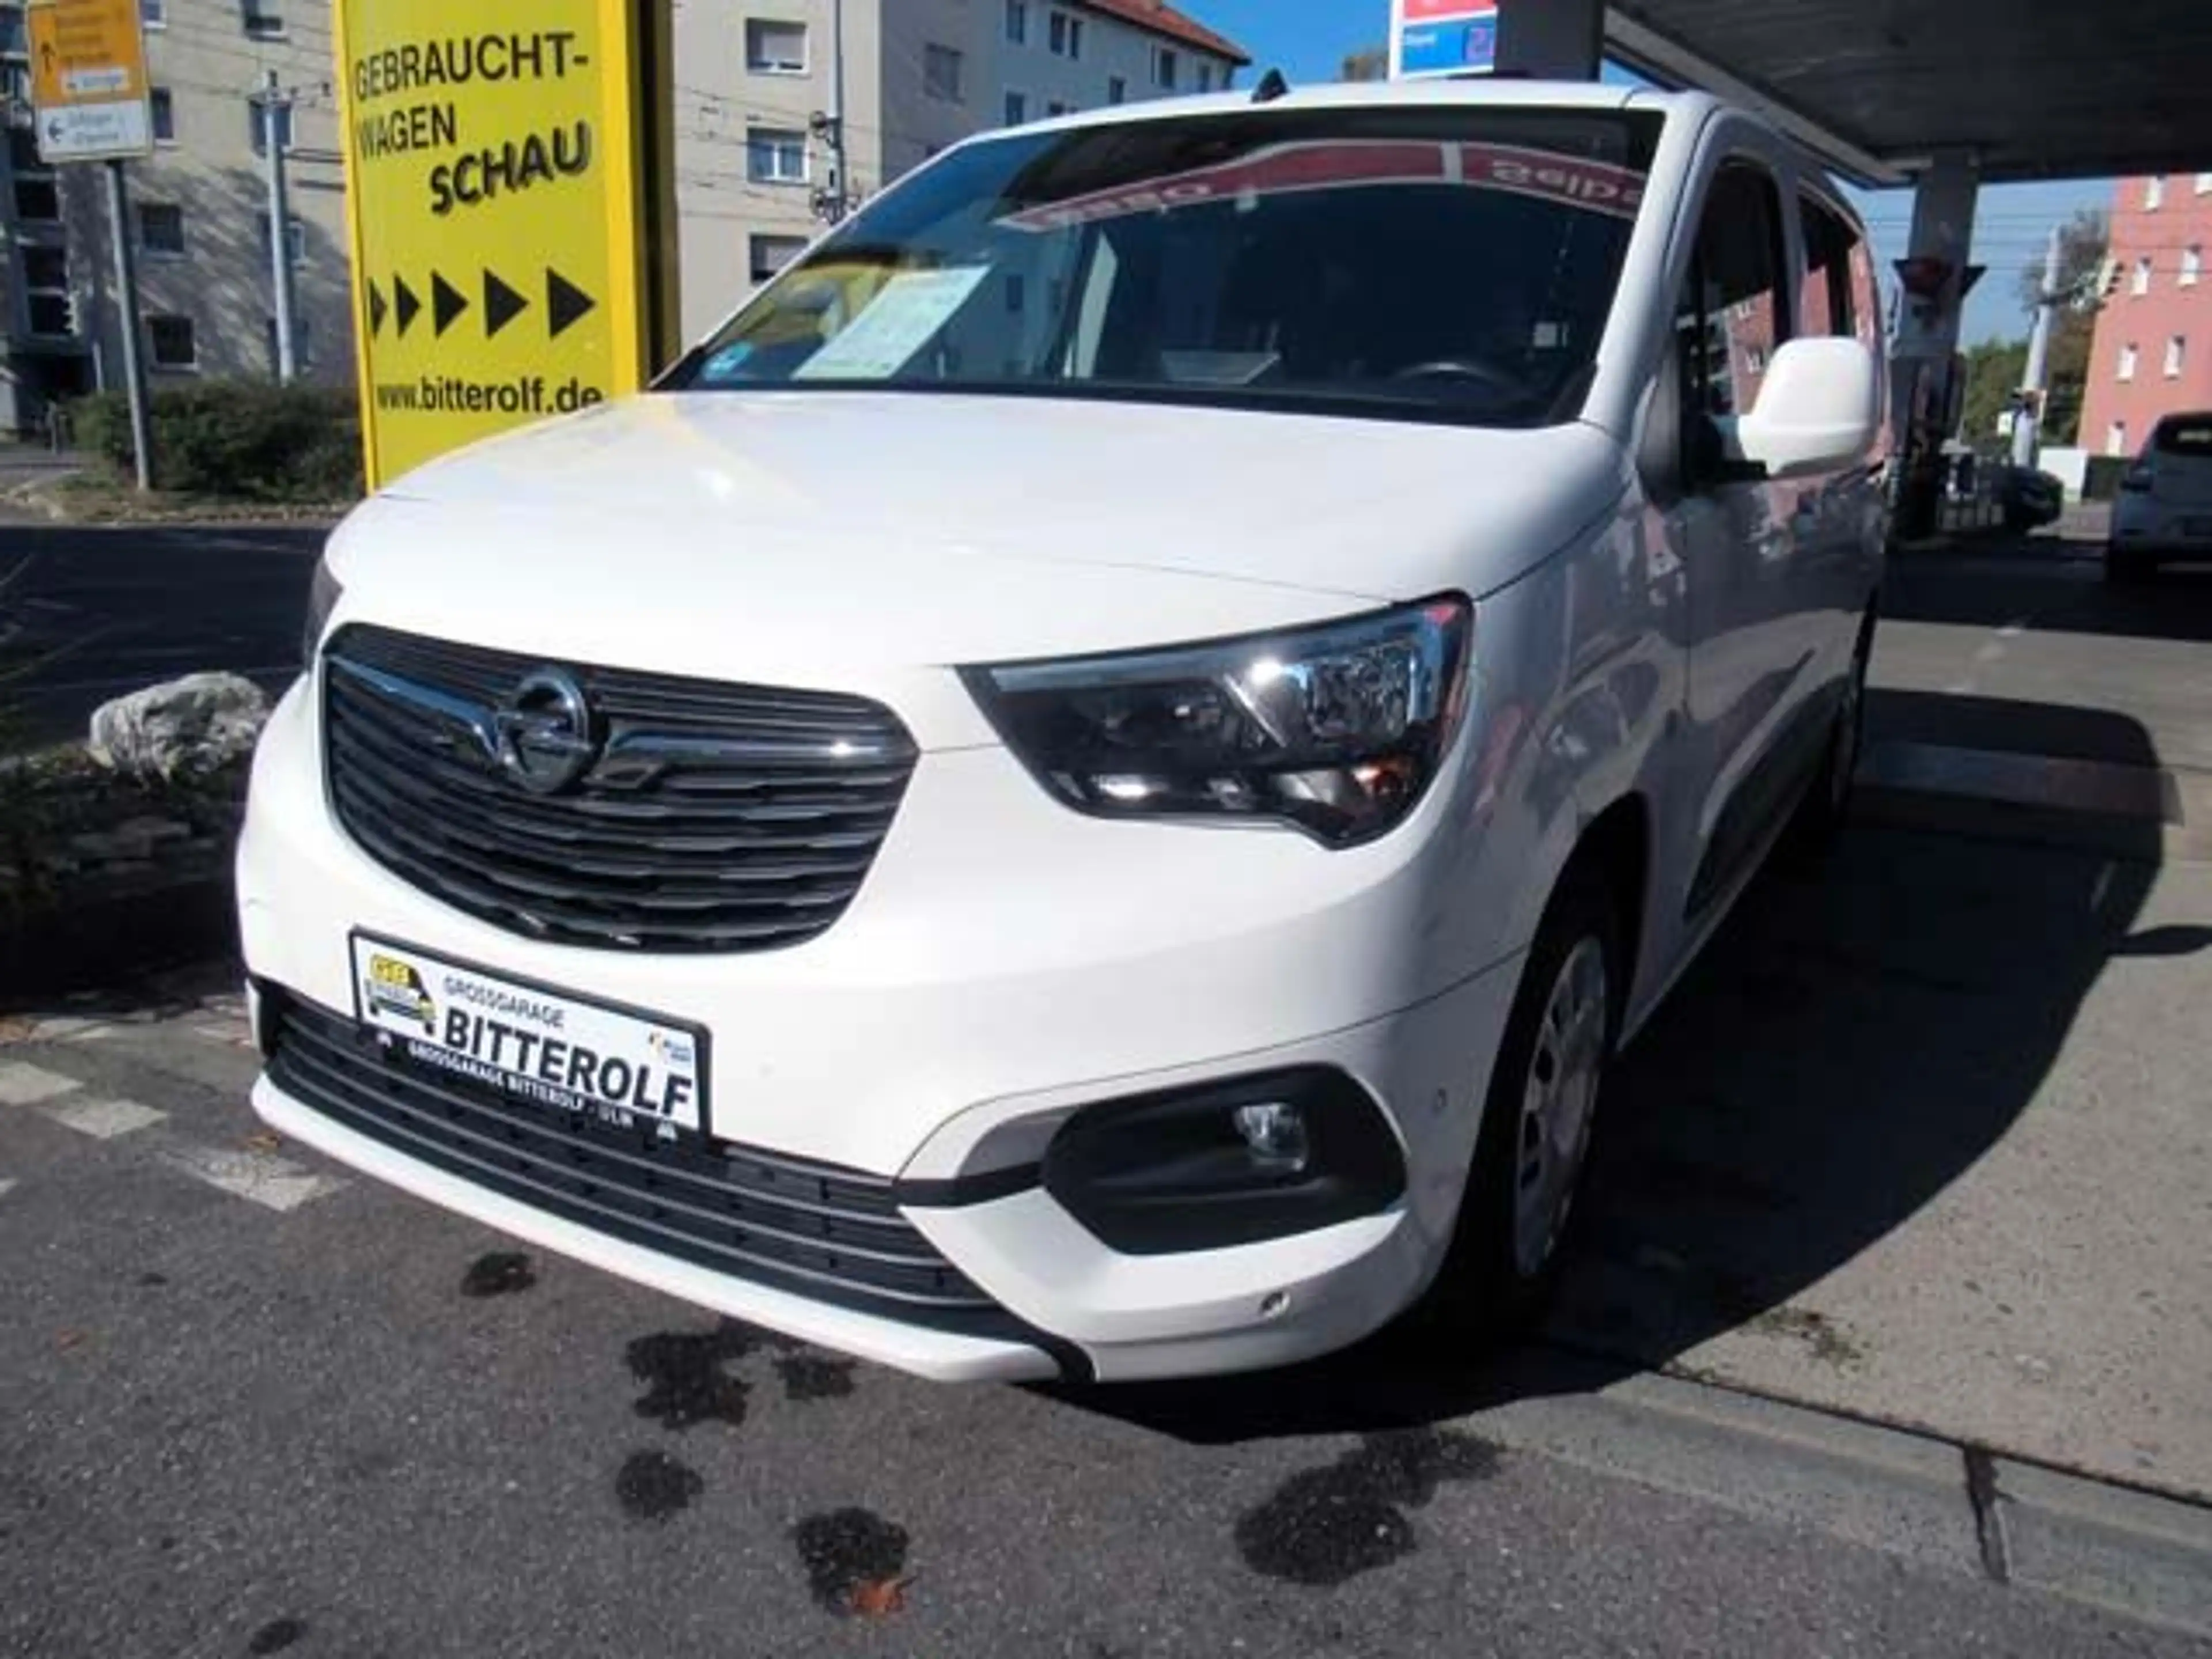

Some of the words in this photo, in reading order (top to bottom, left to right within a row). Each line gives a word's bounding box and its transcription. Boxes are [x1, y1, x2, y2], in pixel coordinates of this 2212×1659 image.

[354, 32, 589, 103] GEBRAUCHT-
[357, 103, 457, 161] WAGEN
[429, 120, 592, 217] SCHAU
[376, 375, 604, 414] www.bitterolf.de
[442, 975, 565, 1030] GROSSGARAGE
[445, 1006, 693, 1116] BITTEROLF
